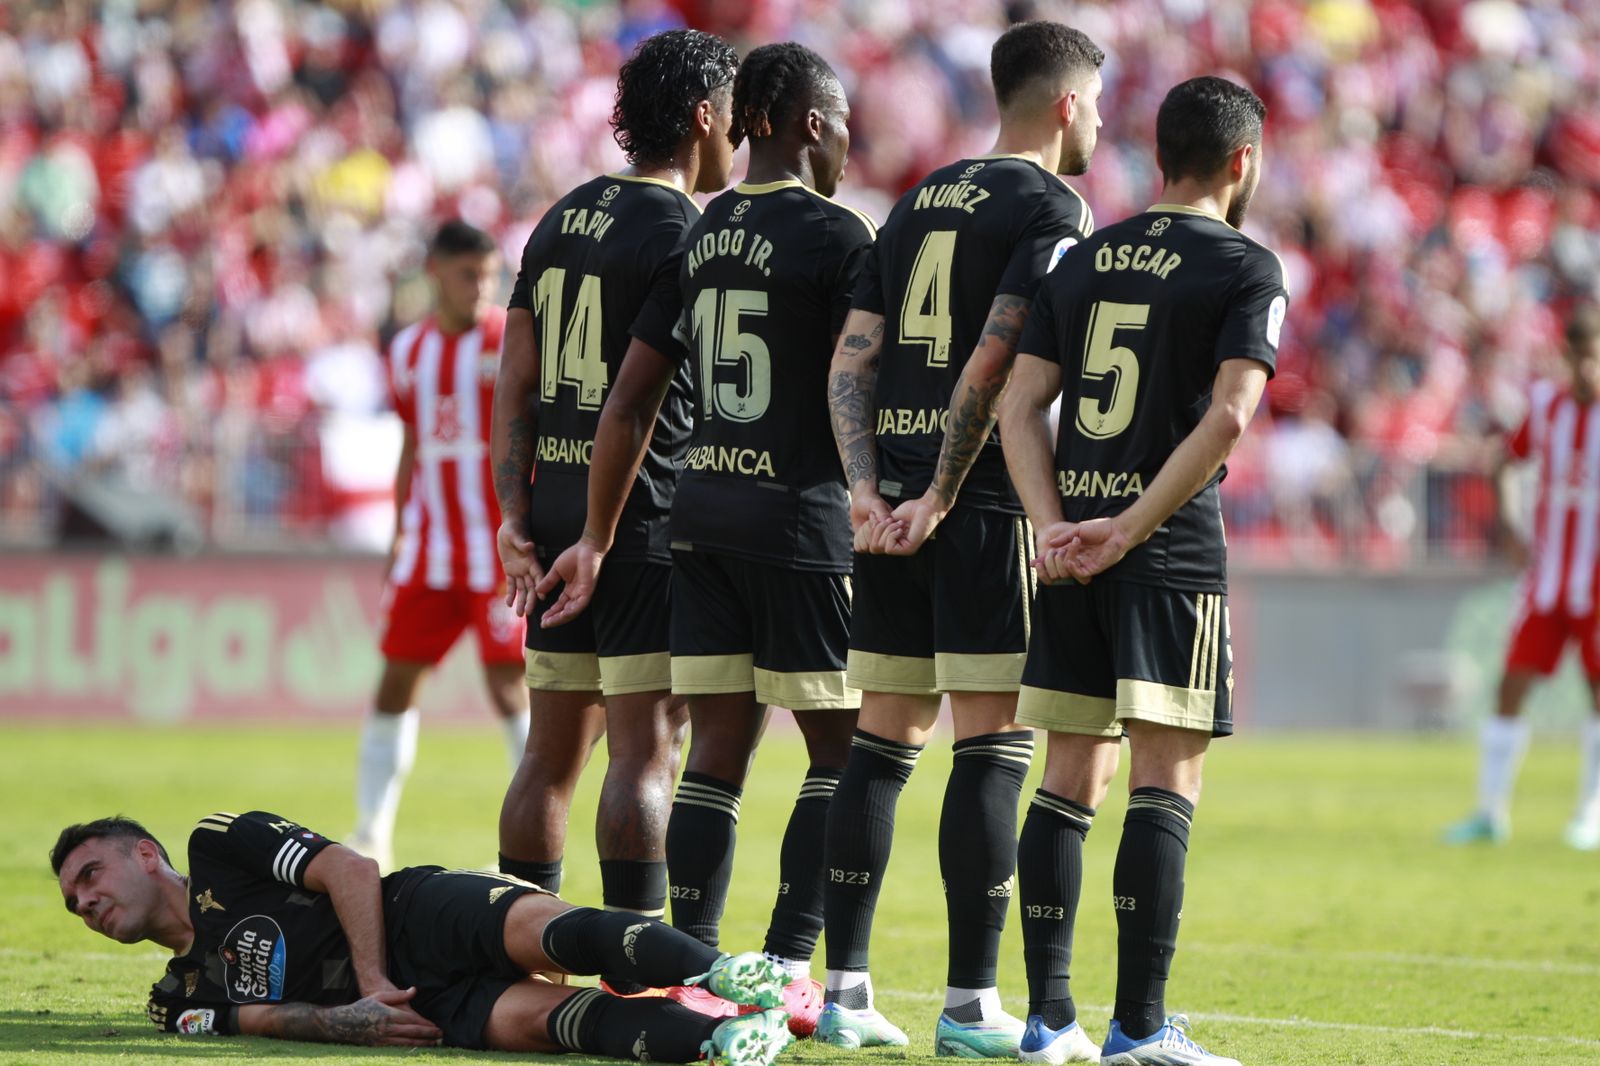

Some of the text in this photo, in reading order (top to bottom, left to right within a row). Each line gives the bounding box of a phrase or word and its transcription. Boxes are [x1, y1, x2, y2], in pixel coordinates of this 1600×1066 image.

[688, 228, 774, 278] AIDOO JR.
[1095, 242, 1182, 280] ÓSCAR
[899, 230, 957, 368] 4
[533, 267, 608, 411] 14
[691, 287, 771, 423] 15
[1075, 300, 1151, 440] 5
[536, 436, 594, 465] ABANC
[670, 886, 700, 900] 1923
[829, 868, 870, 885] 1923
[1026, 905, 1064, 920] 1923
[234, 930, 257, 996] Estrella
[252, 939, 273, 998] Galicia
